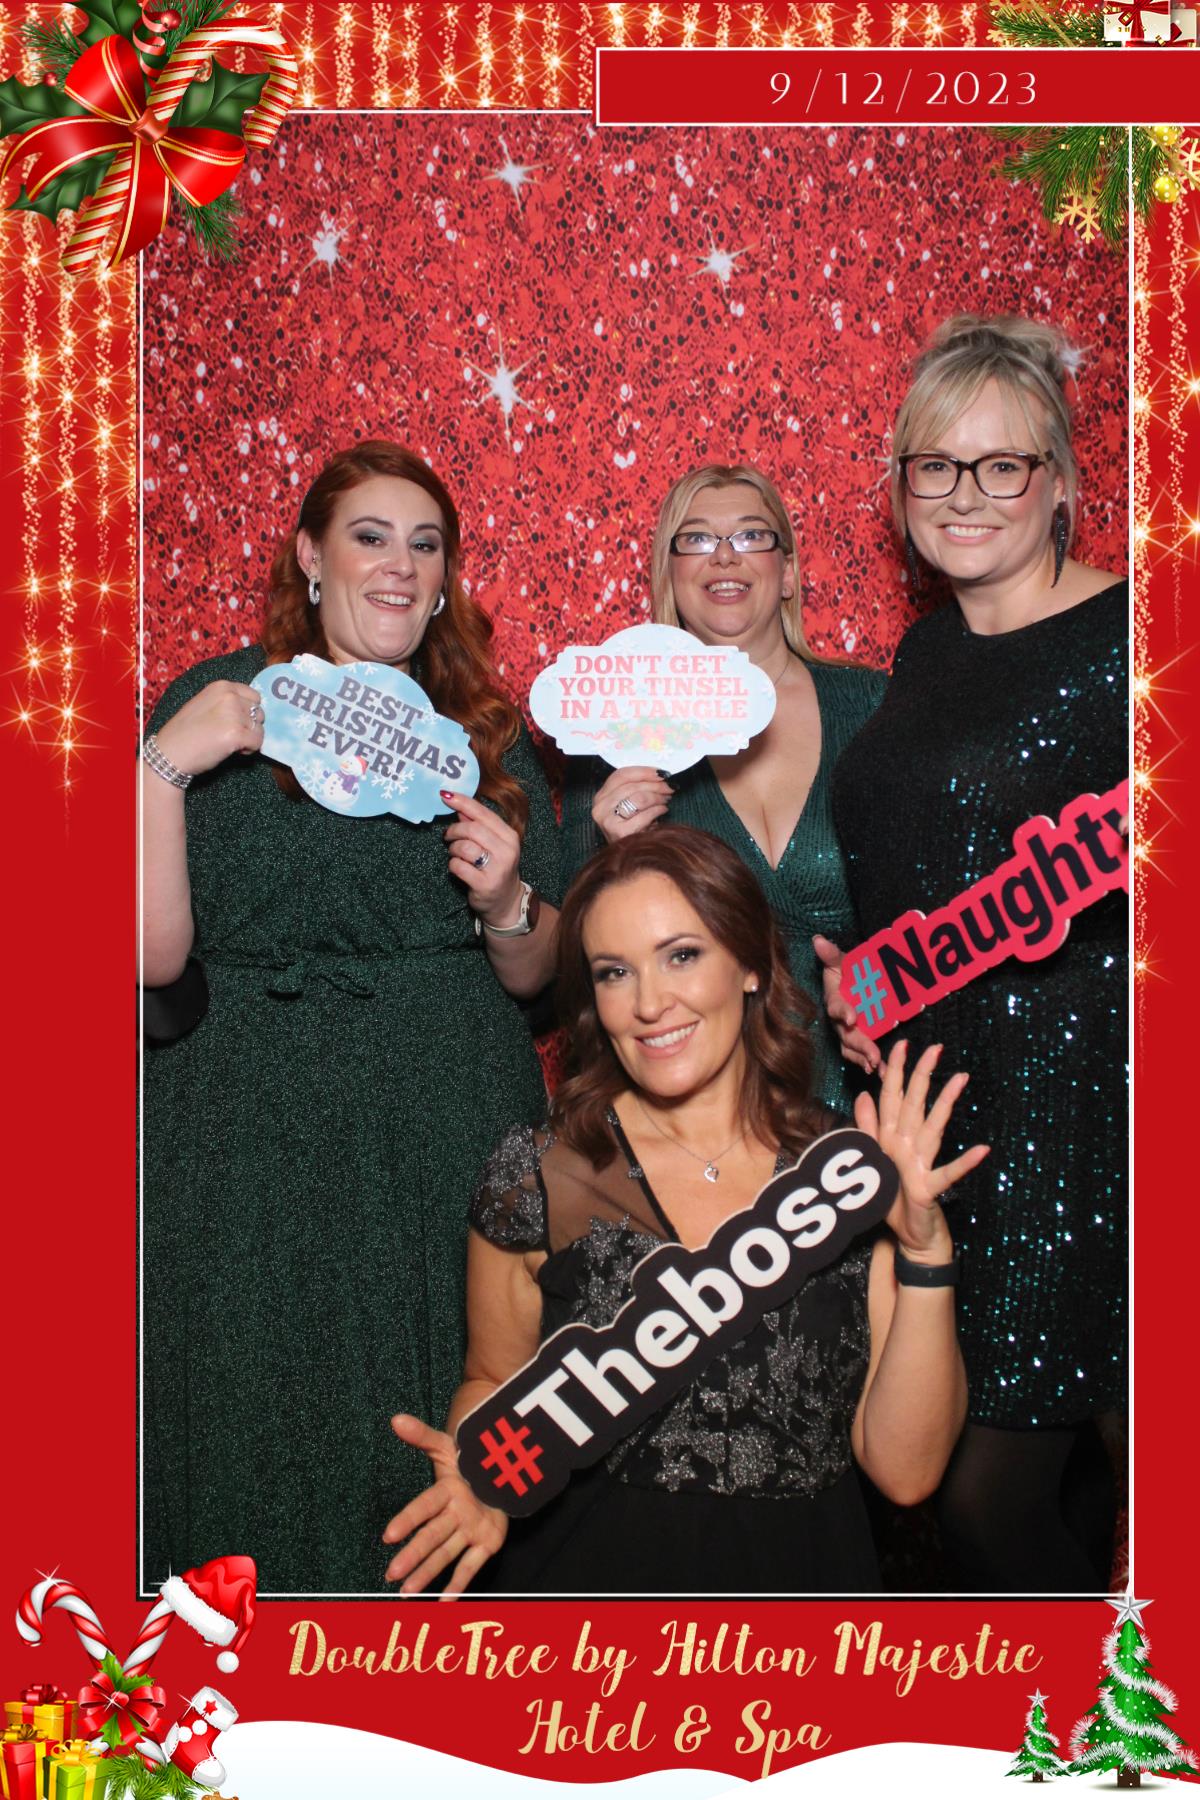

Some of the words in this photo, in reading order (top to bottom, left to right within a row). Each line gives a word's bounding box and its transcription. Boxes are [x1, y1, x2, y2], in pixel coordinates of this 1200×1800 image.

[559, 677, 636, 696] YOUR
[644, 677, 748, 697] TINSEL
[574, 655, 661, 674] DON'T
[669, 655, 727, 674] GET
[271, 676, 466, 780] CHRISTMAS
[336, 676, 423, 730] BEST
[560, 700, 591, 719] IN
[600, 700, 620, 719] A
[629, 700, 748, 720] TANGLE
[308, 722, 406, 781] EVER!
[850, 808, 1128, 1026] #Naught
[479, 1149, 881, 1496] #Theboss
